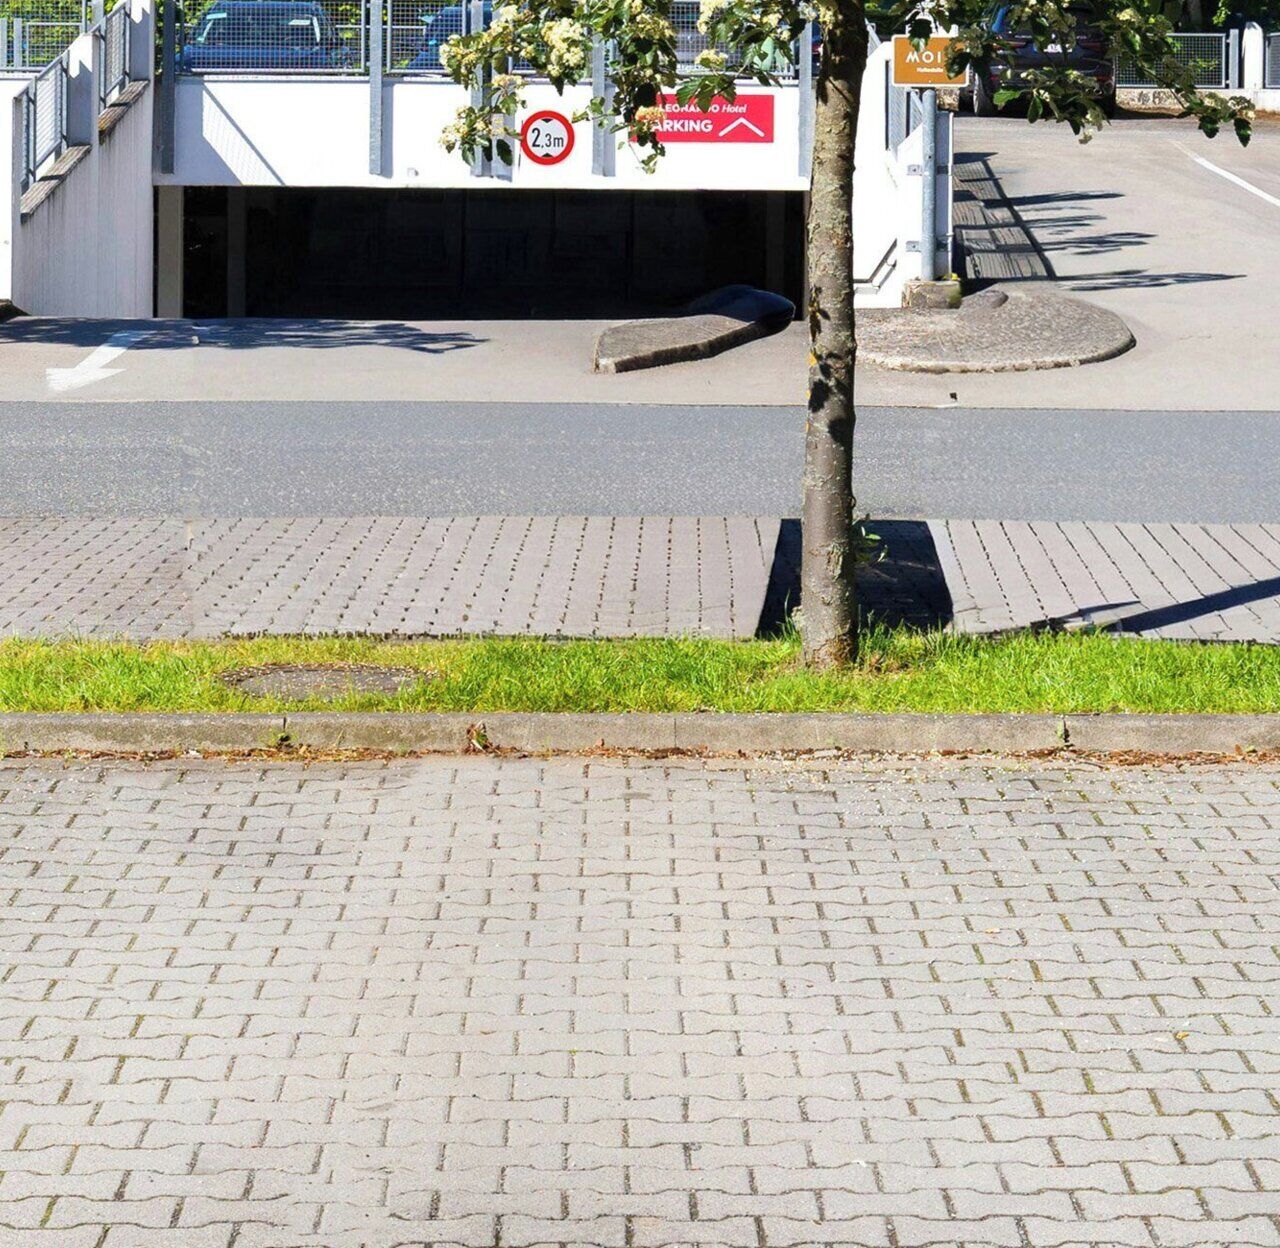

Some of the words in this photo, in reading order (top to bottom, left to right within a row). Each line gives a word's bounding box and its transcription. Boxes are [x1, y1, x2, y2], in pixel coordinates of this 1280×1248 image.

[906, 51, 942, 63] MOI
[721, 104, 747, 113] Hotel
[648, 119, 713, 132] ARKING
